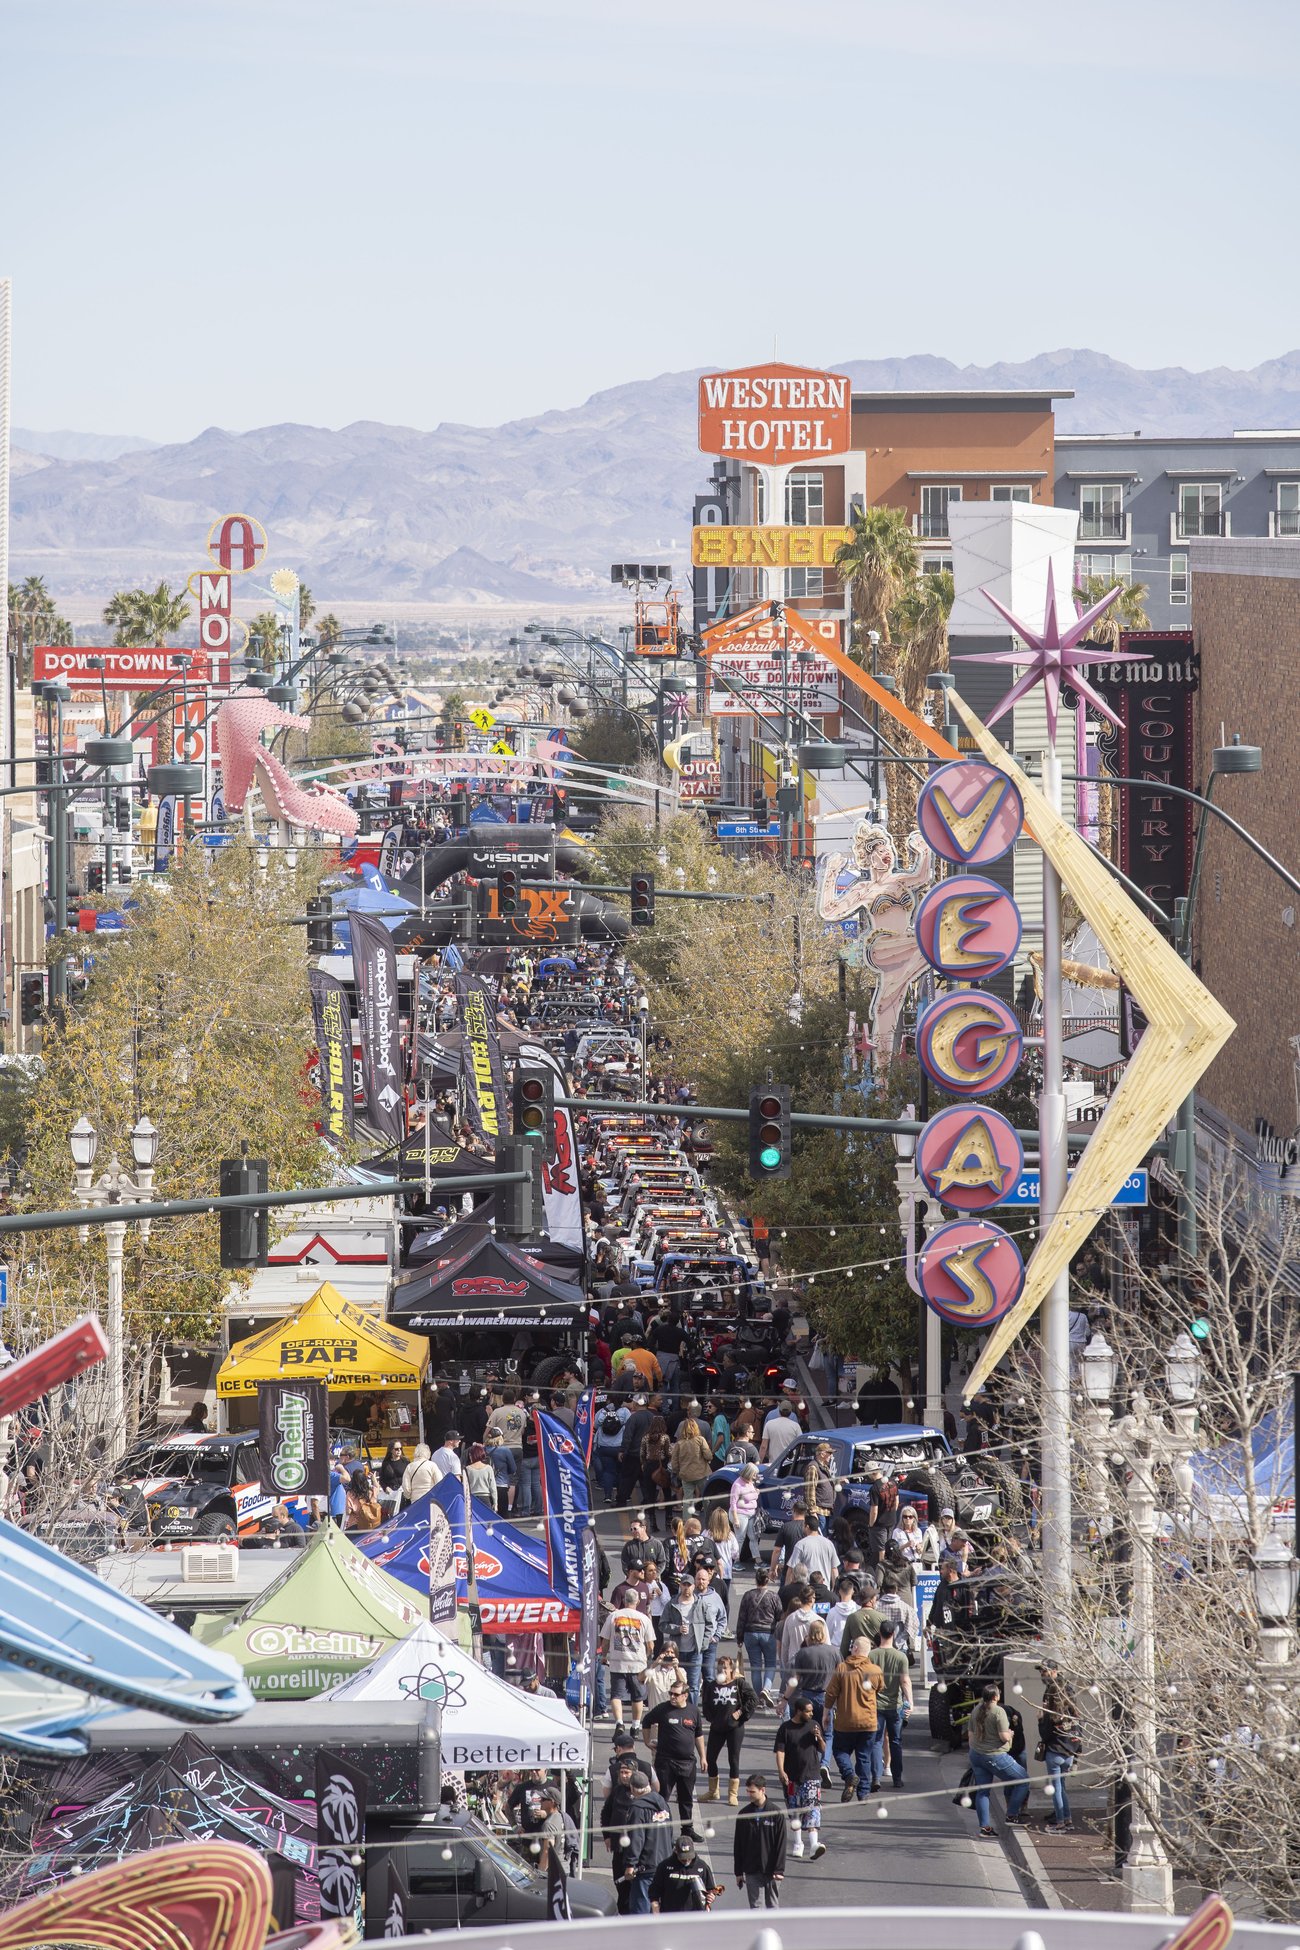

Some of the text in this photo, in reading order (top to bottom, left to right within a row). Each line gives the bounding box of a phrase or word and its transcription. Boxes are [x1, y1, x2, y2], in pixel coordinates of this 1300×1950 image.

[703, 378, 847, 409] WESTERN
[722, 420, 832, 450] HOTEL
[720, 661, 828, 671] HAVE YOU EVENT
[746, 673, 760, 683] US
[1141, 697, 1173, 862] COUNTRY
[735, 826, 747, 834] 8th
[473, 852, 552, 863] VISION
[929, 774, 1023, 1318] VEGAS
[470, 1040, 499, 1136] #DLRW
[1123, 1177, 1141, 1189] 00
[408, 1317, 573, 1326] OFFROADWAREHOUSE.COM
[286, 1339, 353, 1348] OFF-ROAD
[281, 1347, 358, 1364] BAR
[220, 1380, 241, 1392] ICE
[326, 1374, 371, 1385] WATER
[382, 1373, 417, 1384] SODA
[273, 1391, 309, 1490] O'Reilly
[306, 1413, 315, 1461] AUTO PARTS
[559, 1468, 581, 1602] MAKIN' POWER!
[481, 1602, 570, 1623] OWER!
[247, 1624, 385, 1658] O'Reilly
[453, 1745, 530, 1764] Better
[537, 1741, 585, 1763] Life.
